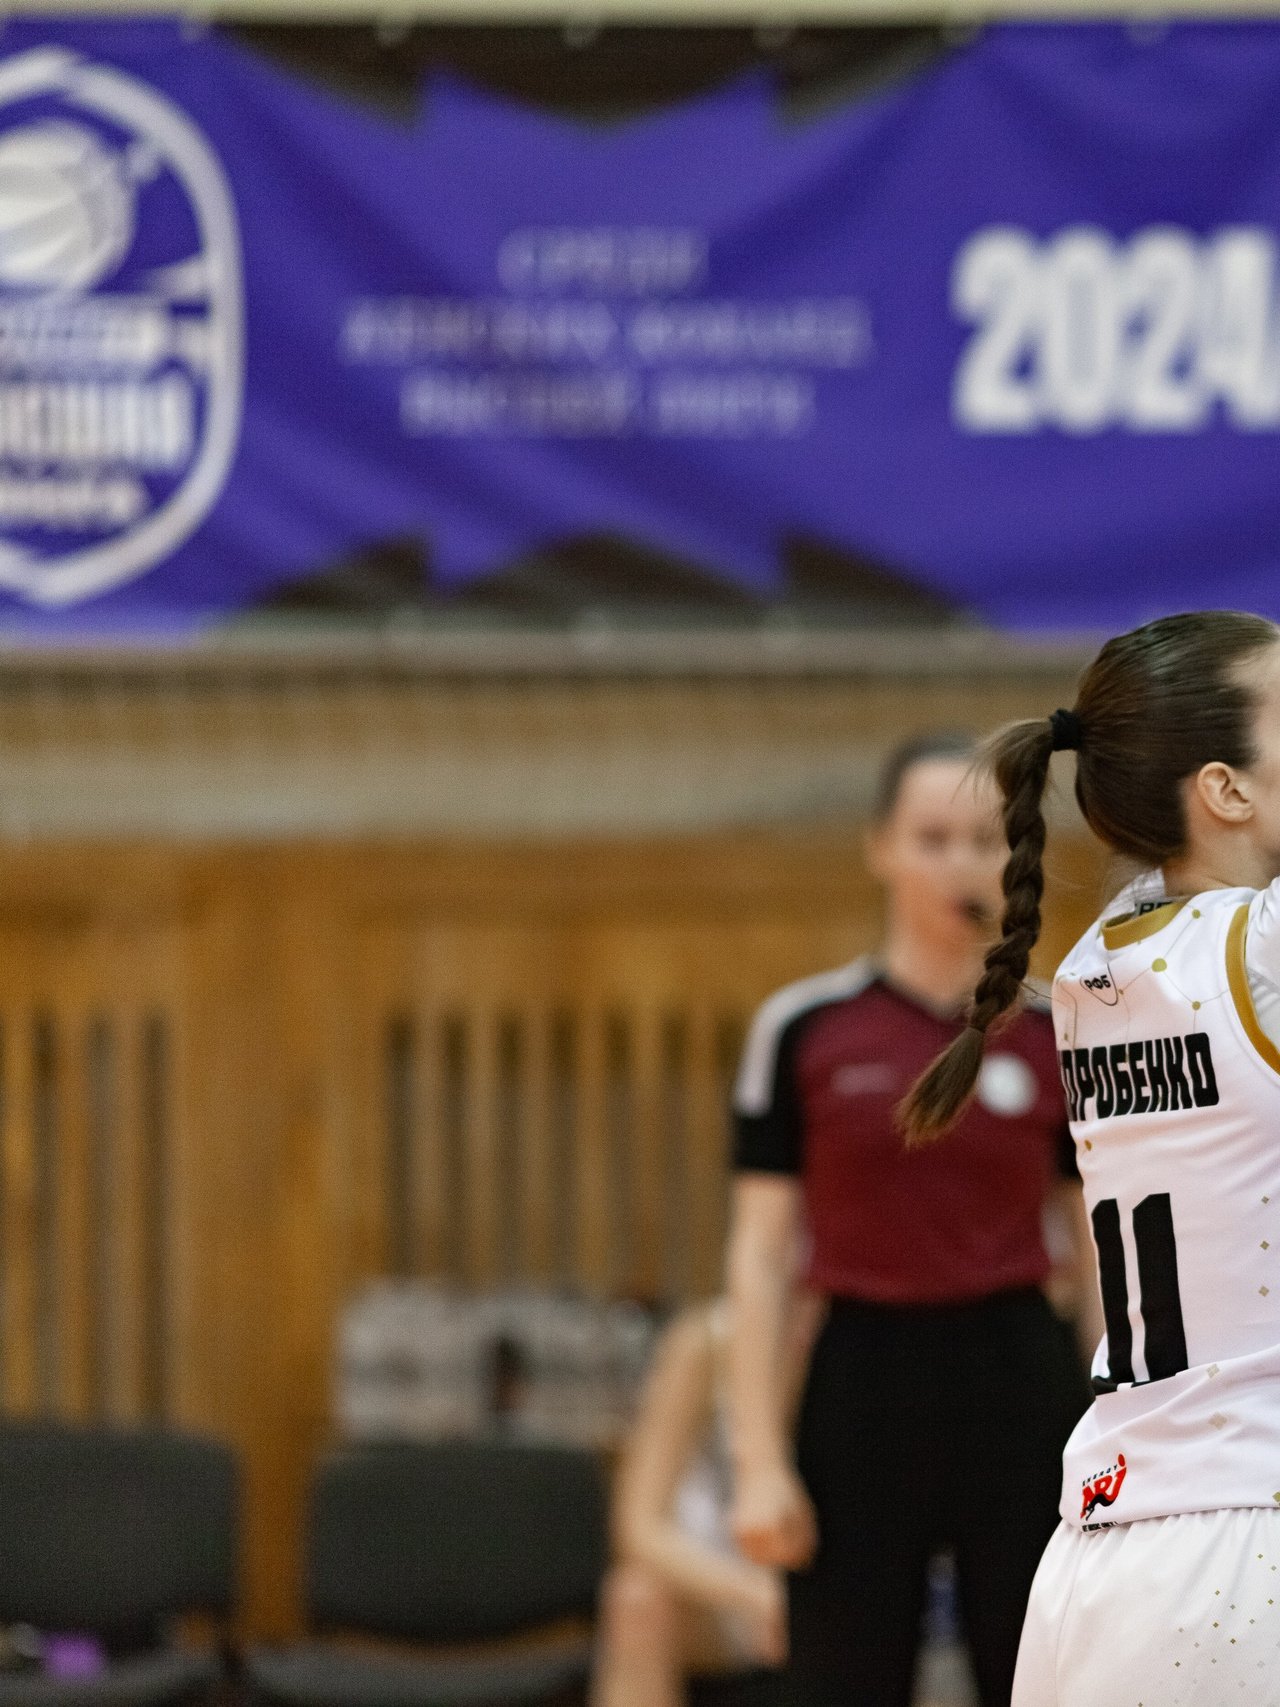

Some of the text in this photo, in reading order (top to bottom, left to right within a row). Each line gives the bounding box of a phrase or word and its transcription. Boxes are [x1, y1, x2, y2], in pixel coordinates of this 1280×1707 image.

[1084, 975, 1111, 990] РФБ
[1057, 1032, 1219, 1122] ОРОБЕНКО
[1091, 1192, 1188, 1396] 11
